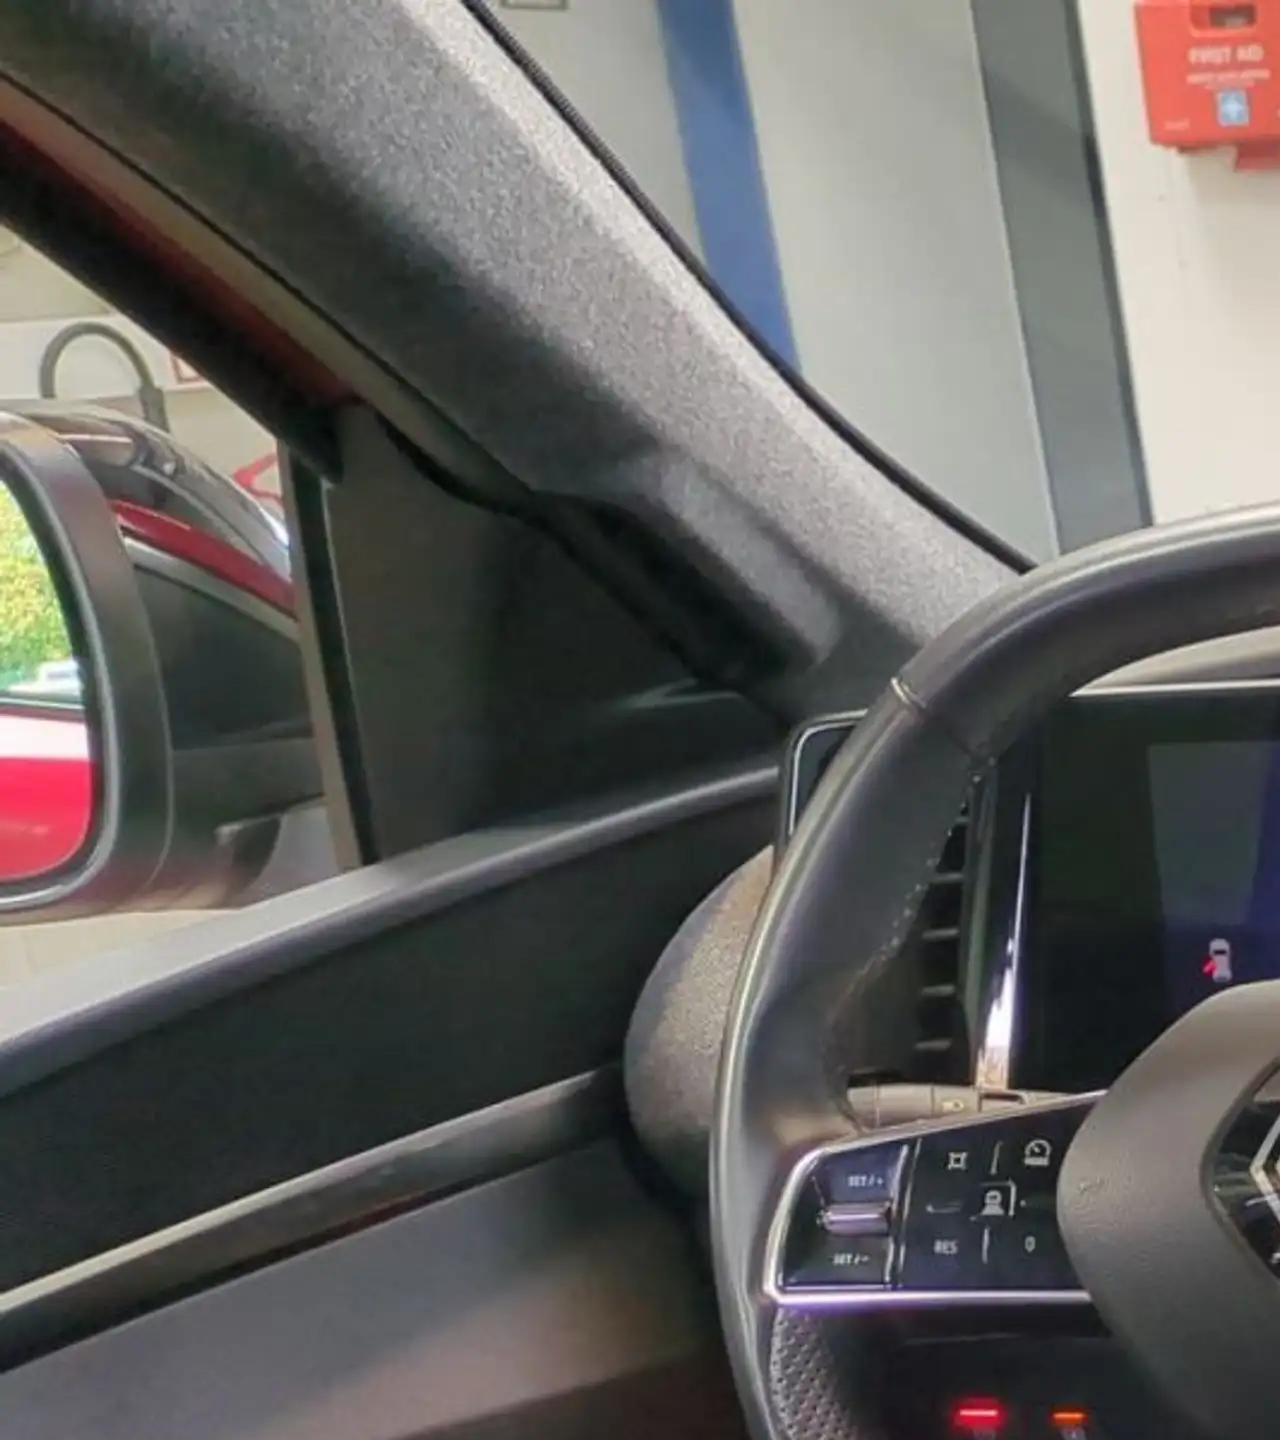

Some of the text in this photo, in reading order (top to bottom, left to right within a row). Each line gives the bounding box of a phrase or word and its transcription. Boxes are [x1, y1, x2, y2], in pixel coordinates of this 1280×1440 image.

[1187, 43, 1264, 65] FIRST AID
[933, 1238, 959, 1255] RES
